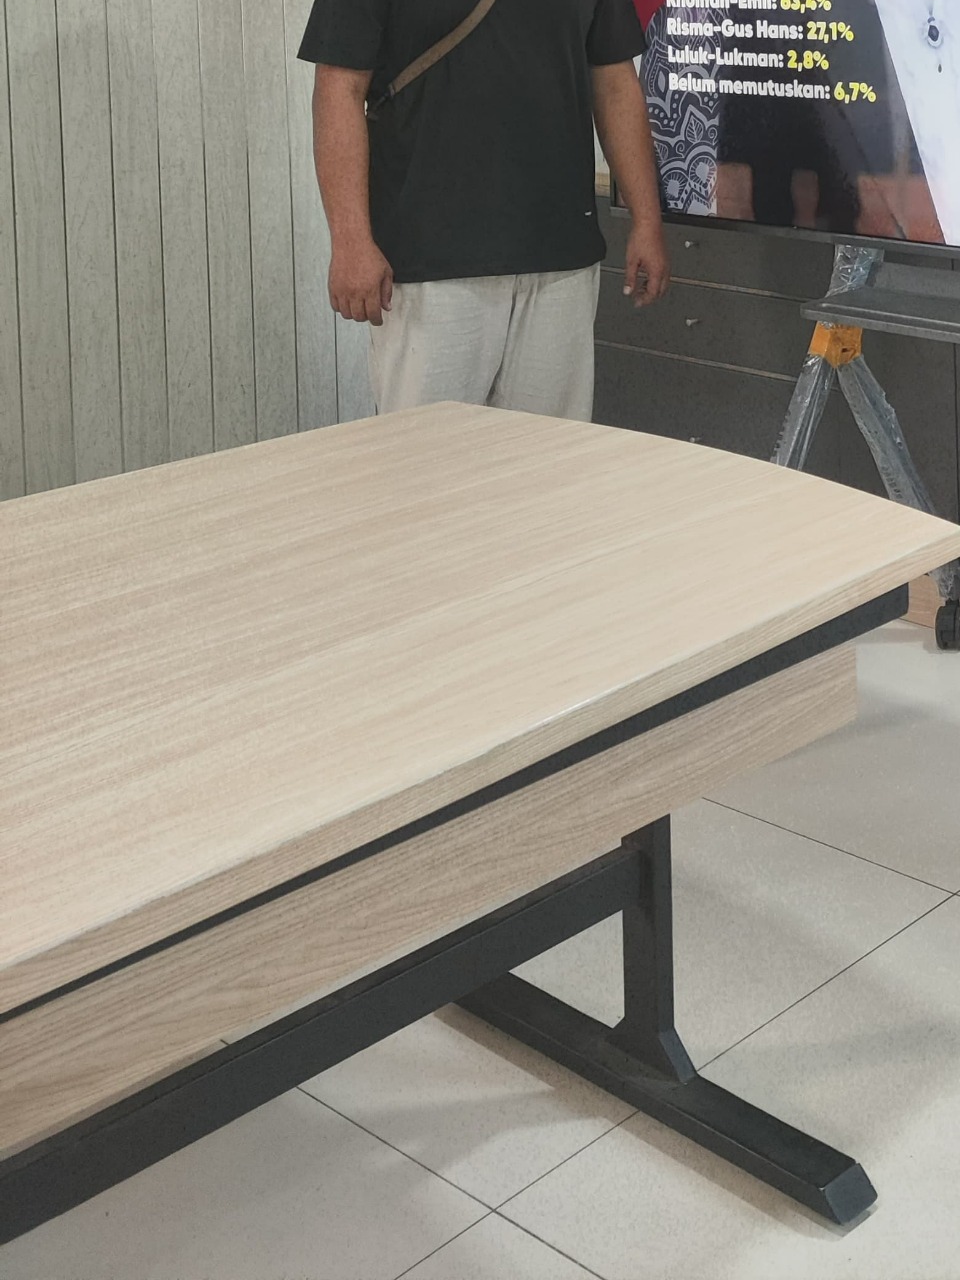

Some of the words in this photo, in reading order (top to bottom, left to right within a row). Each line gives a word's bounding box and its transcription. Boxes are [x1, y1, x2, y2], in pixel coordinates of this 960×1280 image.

[666, 17, 753, 38] Risma-Gus
[756, 19, 803, 40] Hans:
[806, 20, 854, 44] 27,1%
[667, 44, 784, 68] Luluk-Lukman:
[786, 49, 830, 72] 2,8%
[668, 72, 716, 93] Belum
[718, 79, 831, 100] memutuskan:
[833, 81, 877, 104] 6,7%
